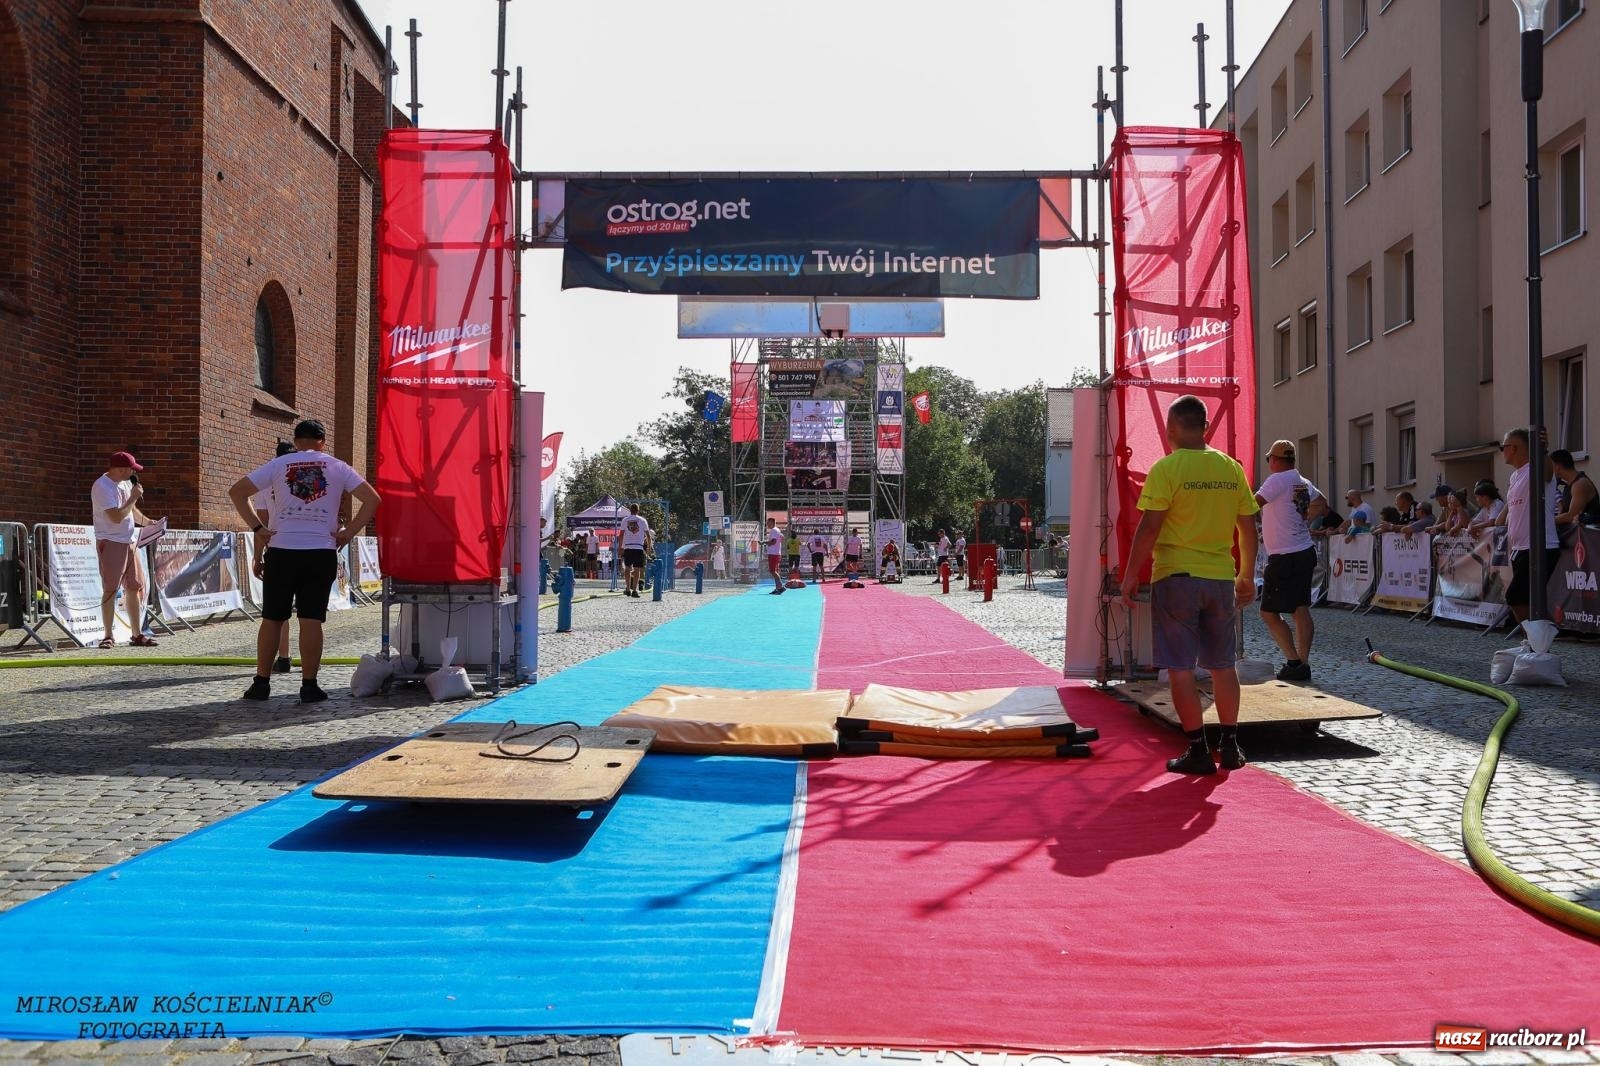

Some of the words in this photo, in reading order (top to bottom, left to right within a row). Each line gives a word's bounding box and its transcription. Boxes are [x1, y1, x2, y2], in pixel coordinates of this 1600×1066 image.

[606, 198, 751, 228] ostrog.net
[608, 223, 645, 236] łączymy
[646, 222, 657, 232] od
[659, 222, 671, 231] 20
[672, 221, 688, 231] lat!
[605, 248, 805, 277] Przyśpieszamy
[811, 248, 875, 278] Twój
[884, 251, 996, 276] Internet
[388, 319, 491, 358] Milwaukee
[1120, 318, 1232, 359] Milwaukee
[770, 361, 822, 369] WYBURZENIA
[382, 376, 411, 386] Nothing
[413, 376, 428, 385] but
[429, 376, 465, 385] HEAVY
[1170, 376, 1207, 385] HEAVY
[1183, 481, 1238, 491] ORGANIZATOR
[723, 516, 731, 528] P
